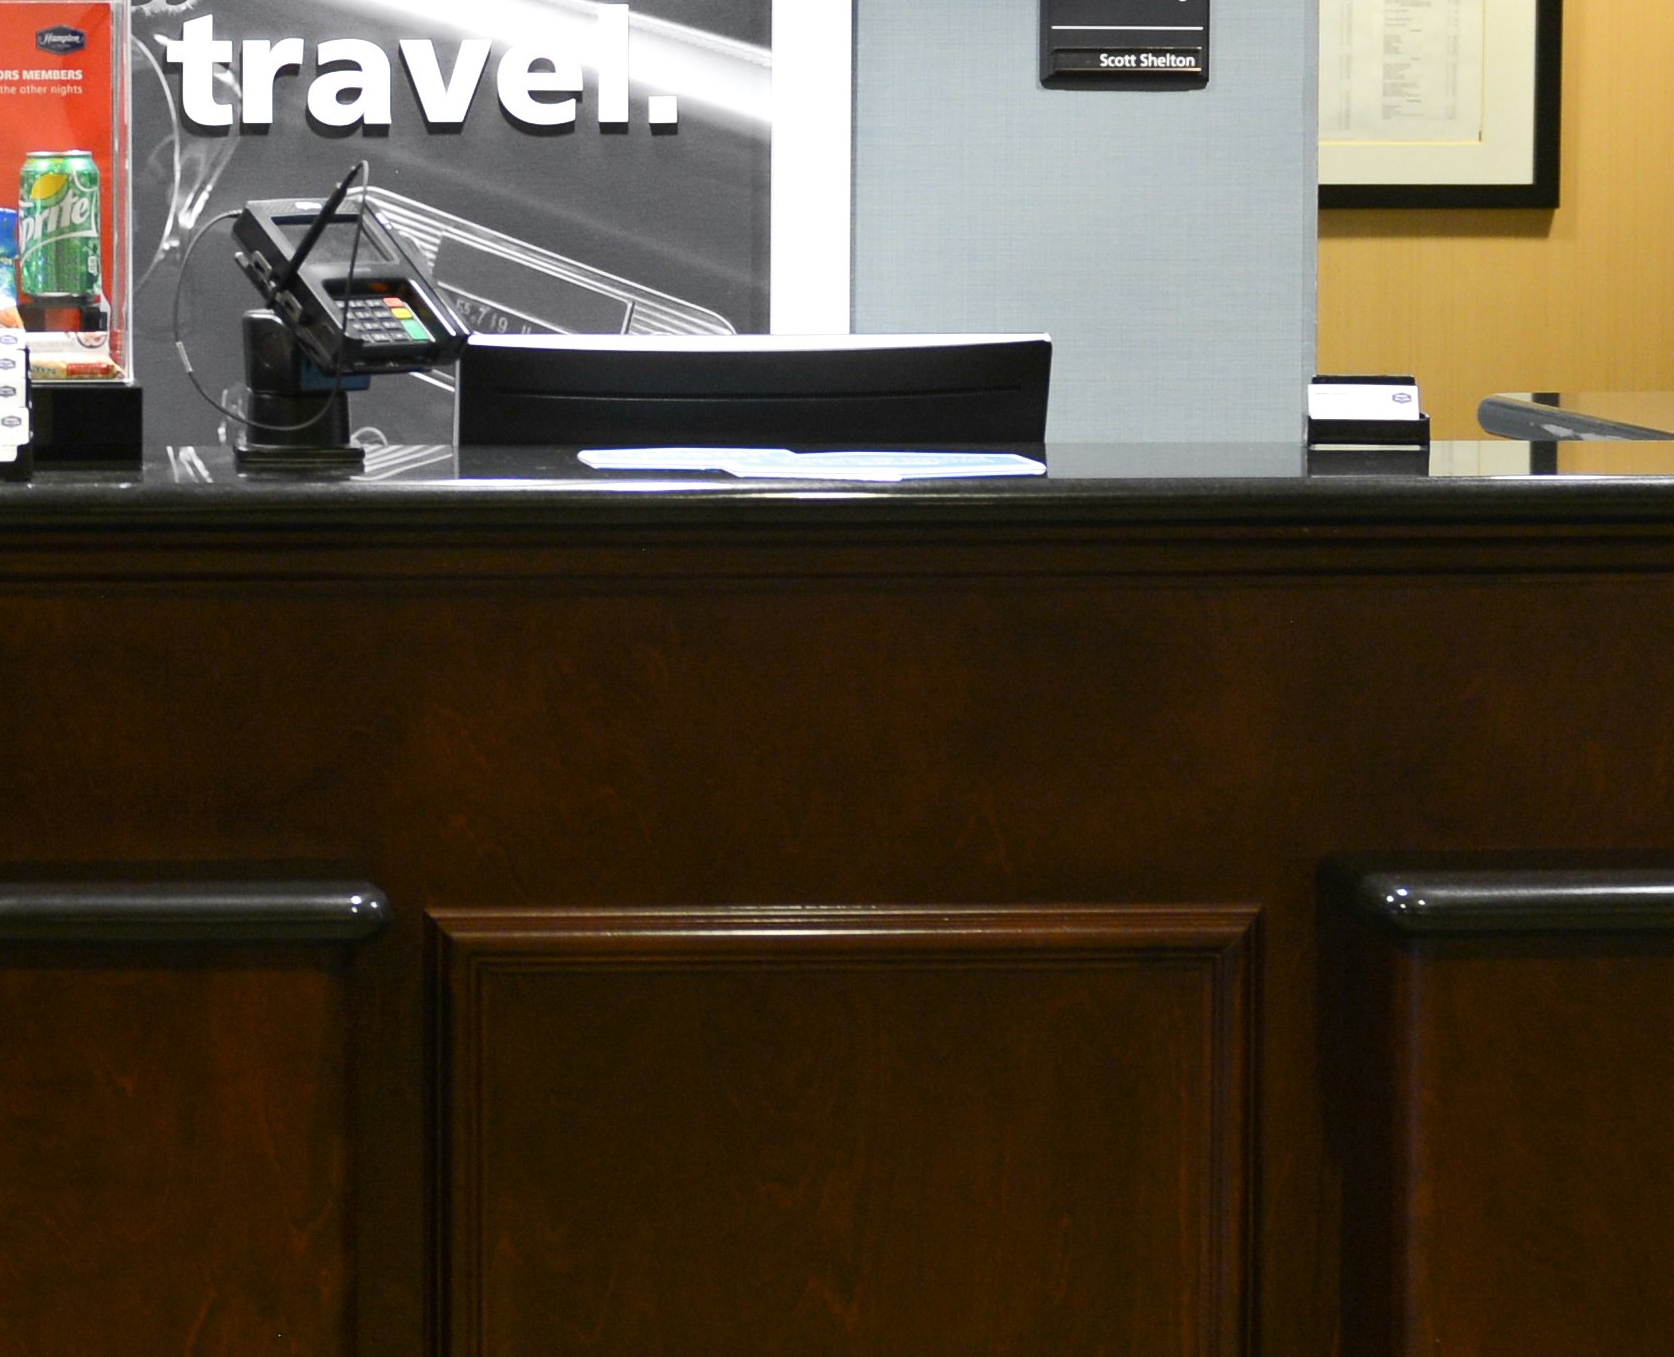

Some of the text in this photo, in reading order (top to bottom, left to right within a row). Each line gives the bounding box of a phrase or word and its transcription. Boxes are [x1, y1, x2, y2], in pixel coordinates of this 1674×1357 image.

[166, 4, 680, 127] travel.
[1099, 53, 1196, 68] Scott Shelton
[21, 70, 83, 81] MEMBERS
[0, 84, 17, 95] the
[19, 84, 47, 95] other
[50, 84, 83, 97] nights
